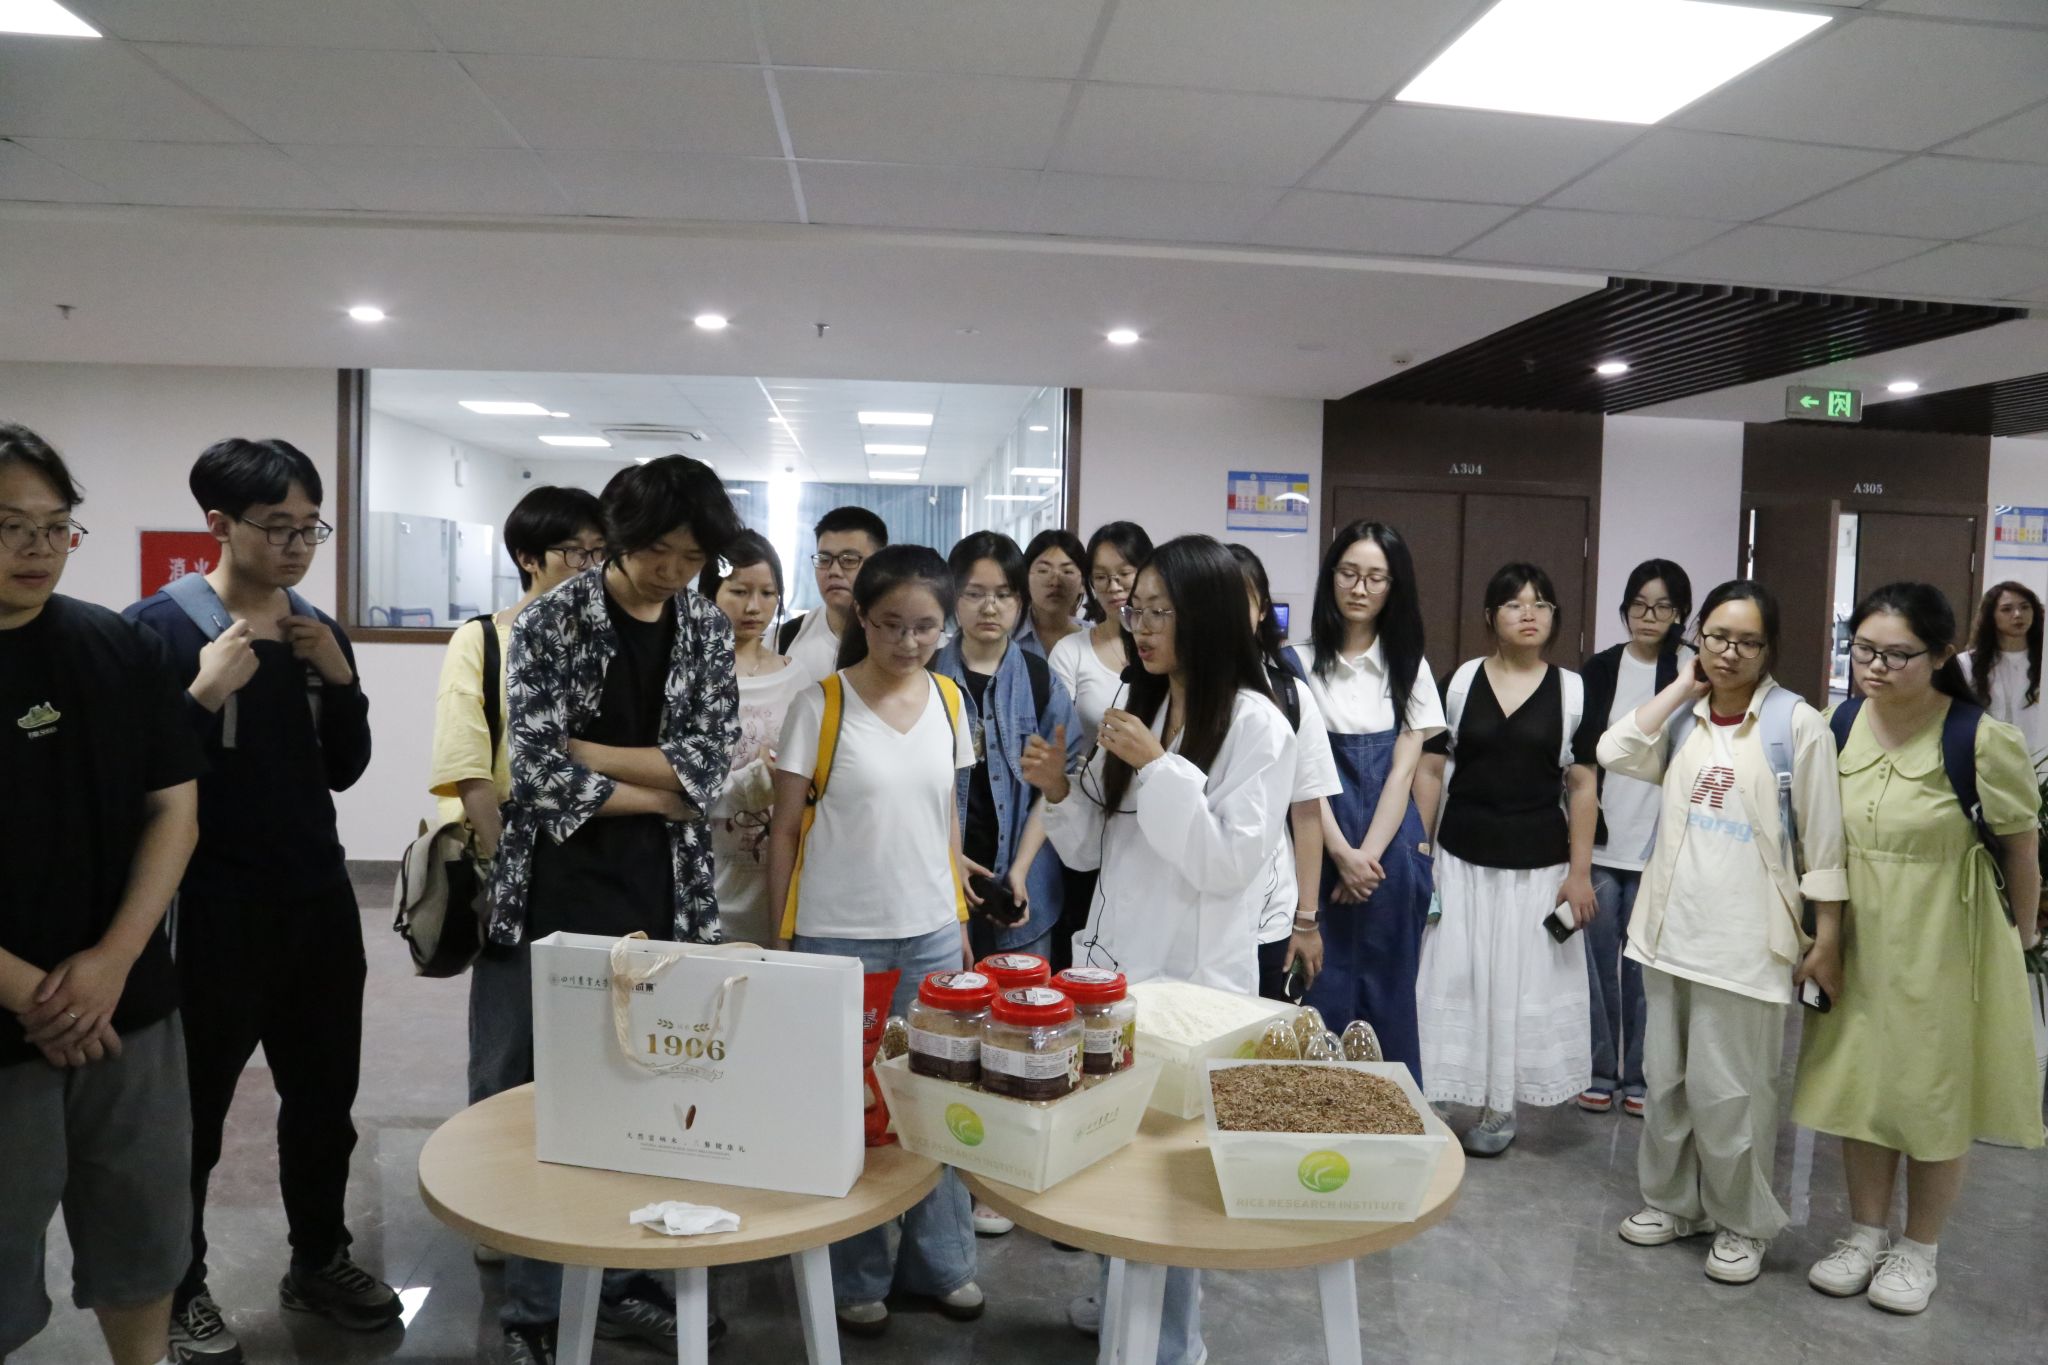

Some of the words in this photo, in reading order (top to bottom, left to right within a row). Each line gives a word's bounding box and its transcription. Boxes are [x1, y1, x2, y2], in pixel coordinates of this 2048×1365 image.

[1448, 463, 1483, 476] A304
[1853, 482, 1883, 495] A305
[646, 1032, 726, 1062] 1906
[1235, 1197, 1265, 1208] RICE
[1268, 1198, 1337, 1210] RESEARCH
[1339, 1199, 1409, 1211] INSTITUTE
